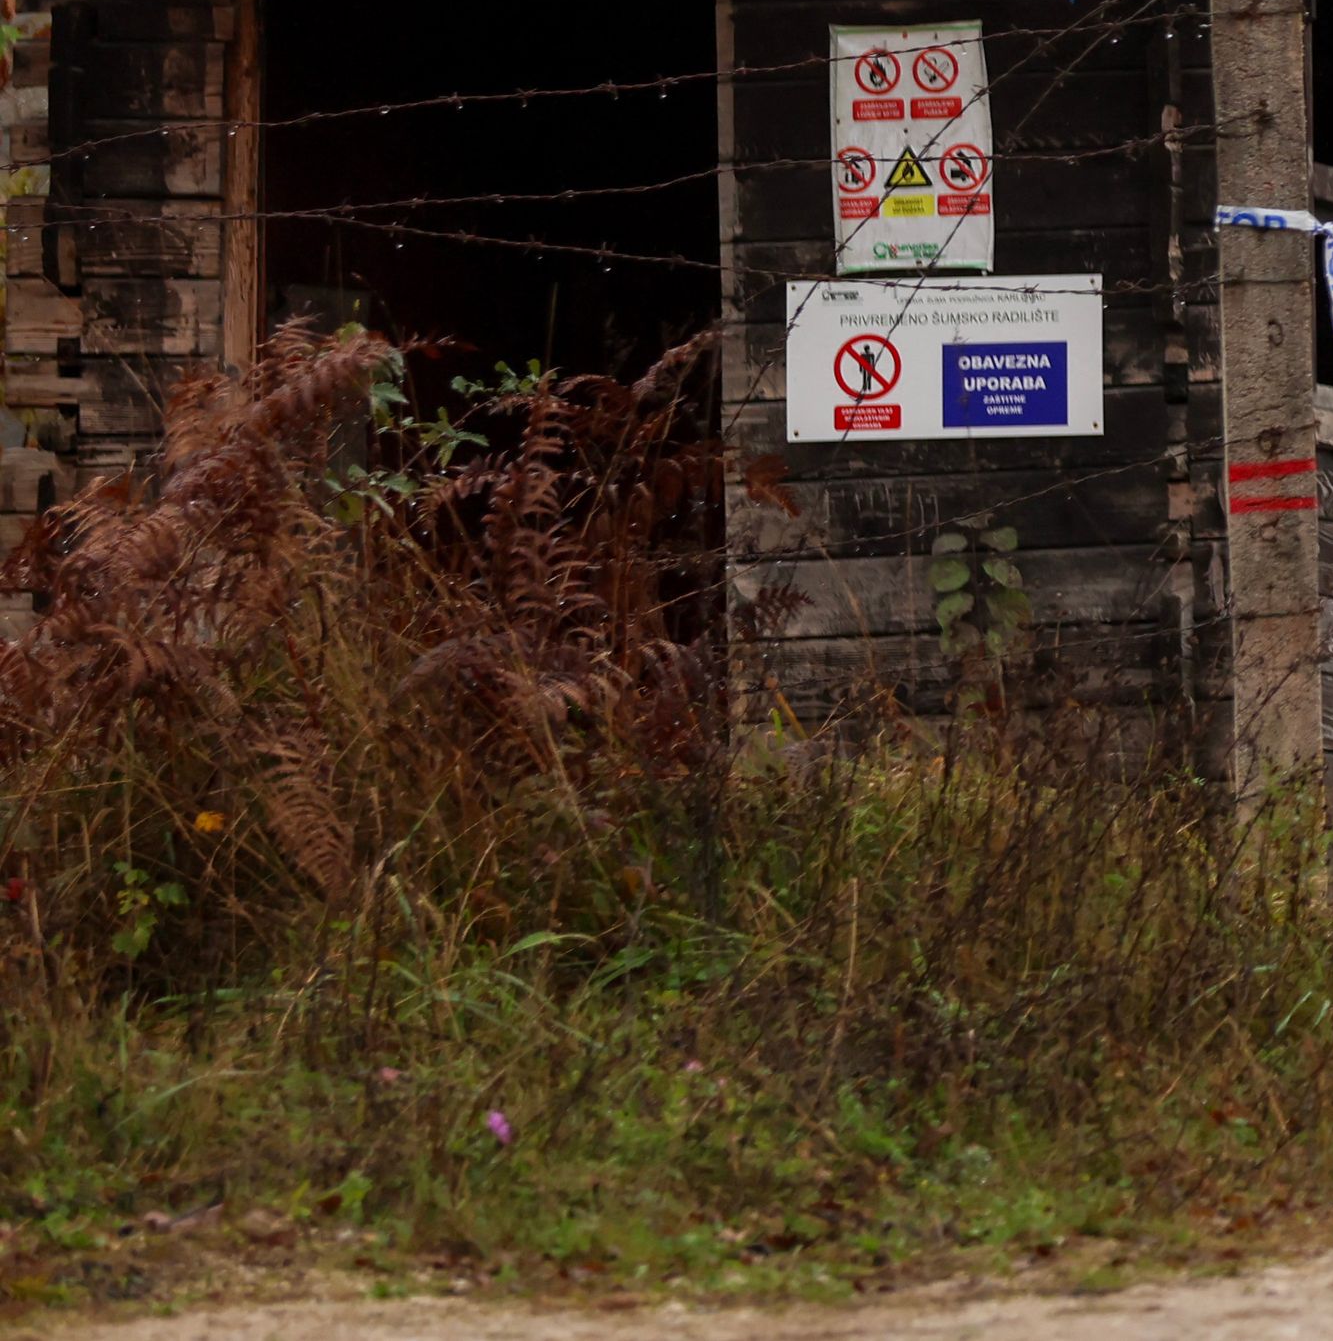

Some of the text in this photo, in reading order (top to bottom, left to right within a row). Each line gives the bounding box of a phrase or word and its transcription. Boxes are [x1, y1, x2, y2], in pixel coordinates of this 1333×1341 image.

[839, 309, 1061, 327] PRIVREMENO ŠUMSKO RADILIŠTE
[958, 354, 1052, 370] OBAVEZNA
[962, 375, 1047, 391] UPORABA
